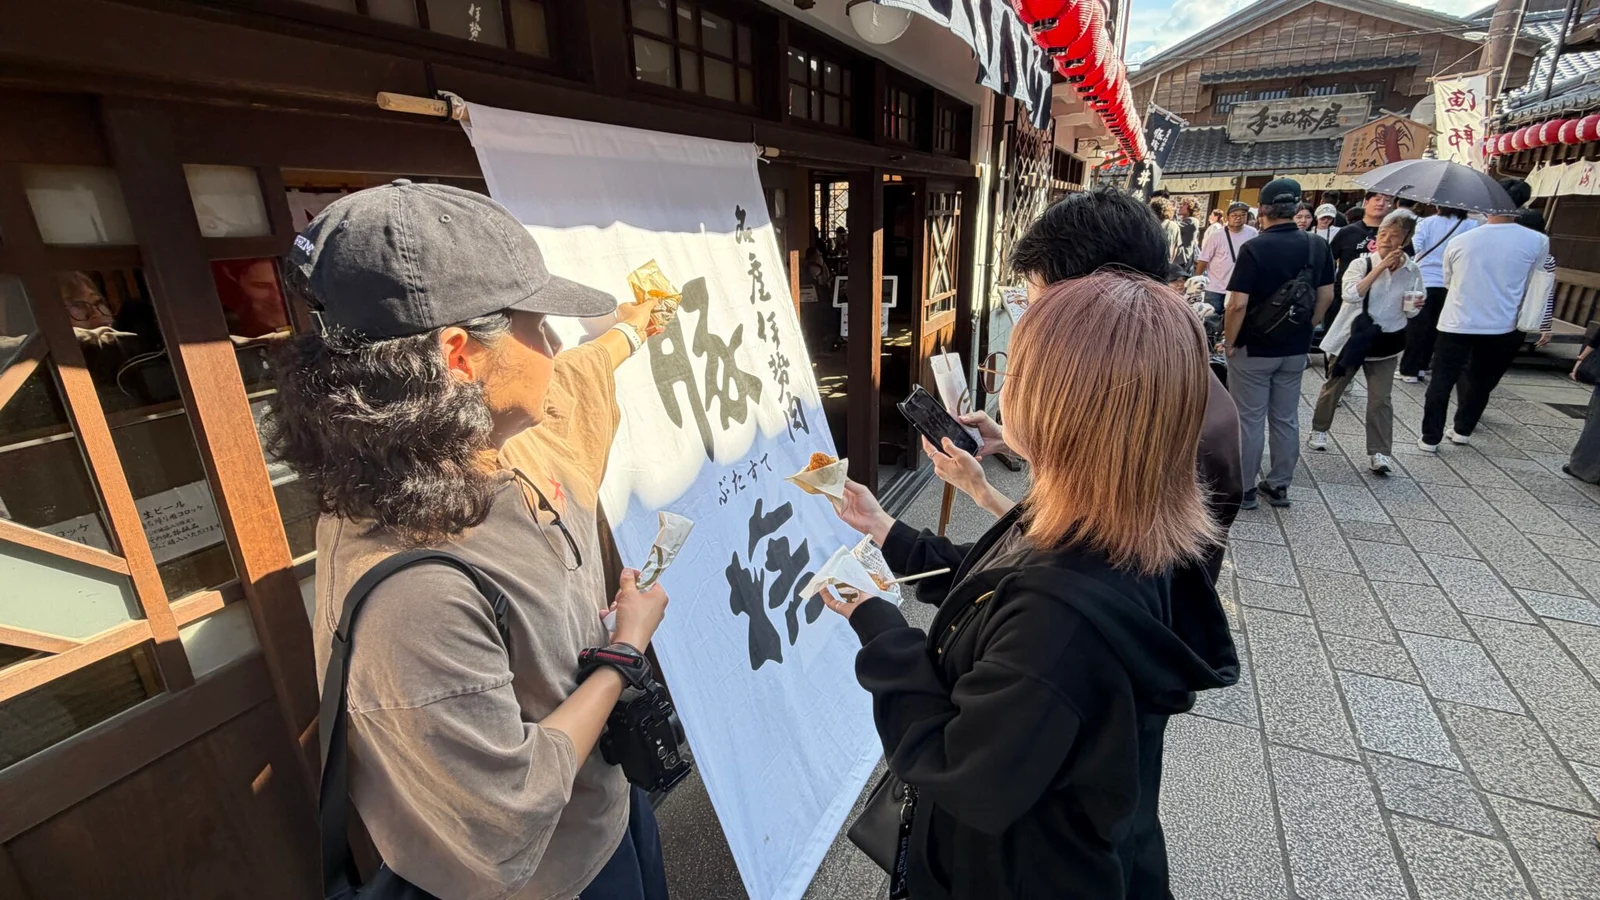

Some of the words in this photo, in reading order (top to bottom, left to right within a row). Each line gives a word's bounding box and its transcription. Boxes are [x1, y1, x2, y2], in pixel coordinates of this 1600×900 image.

[1246, 102, 1343, 136] 手こね茶屋
[718, 452, 773, 506] ぶたすて
[143, 500, 186, 520] 生ビール
